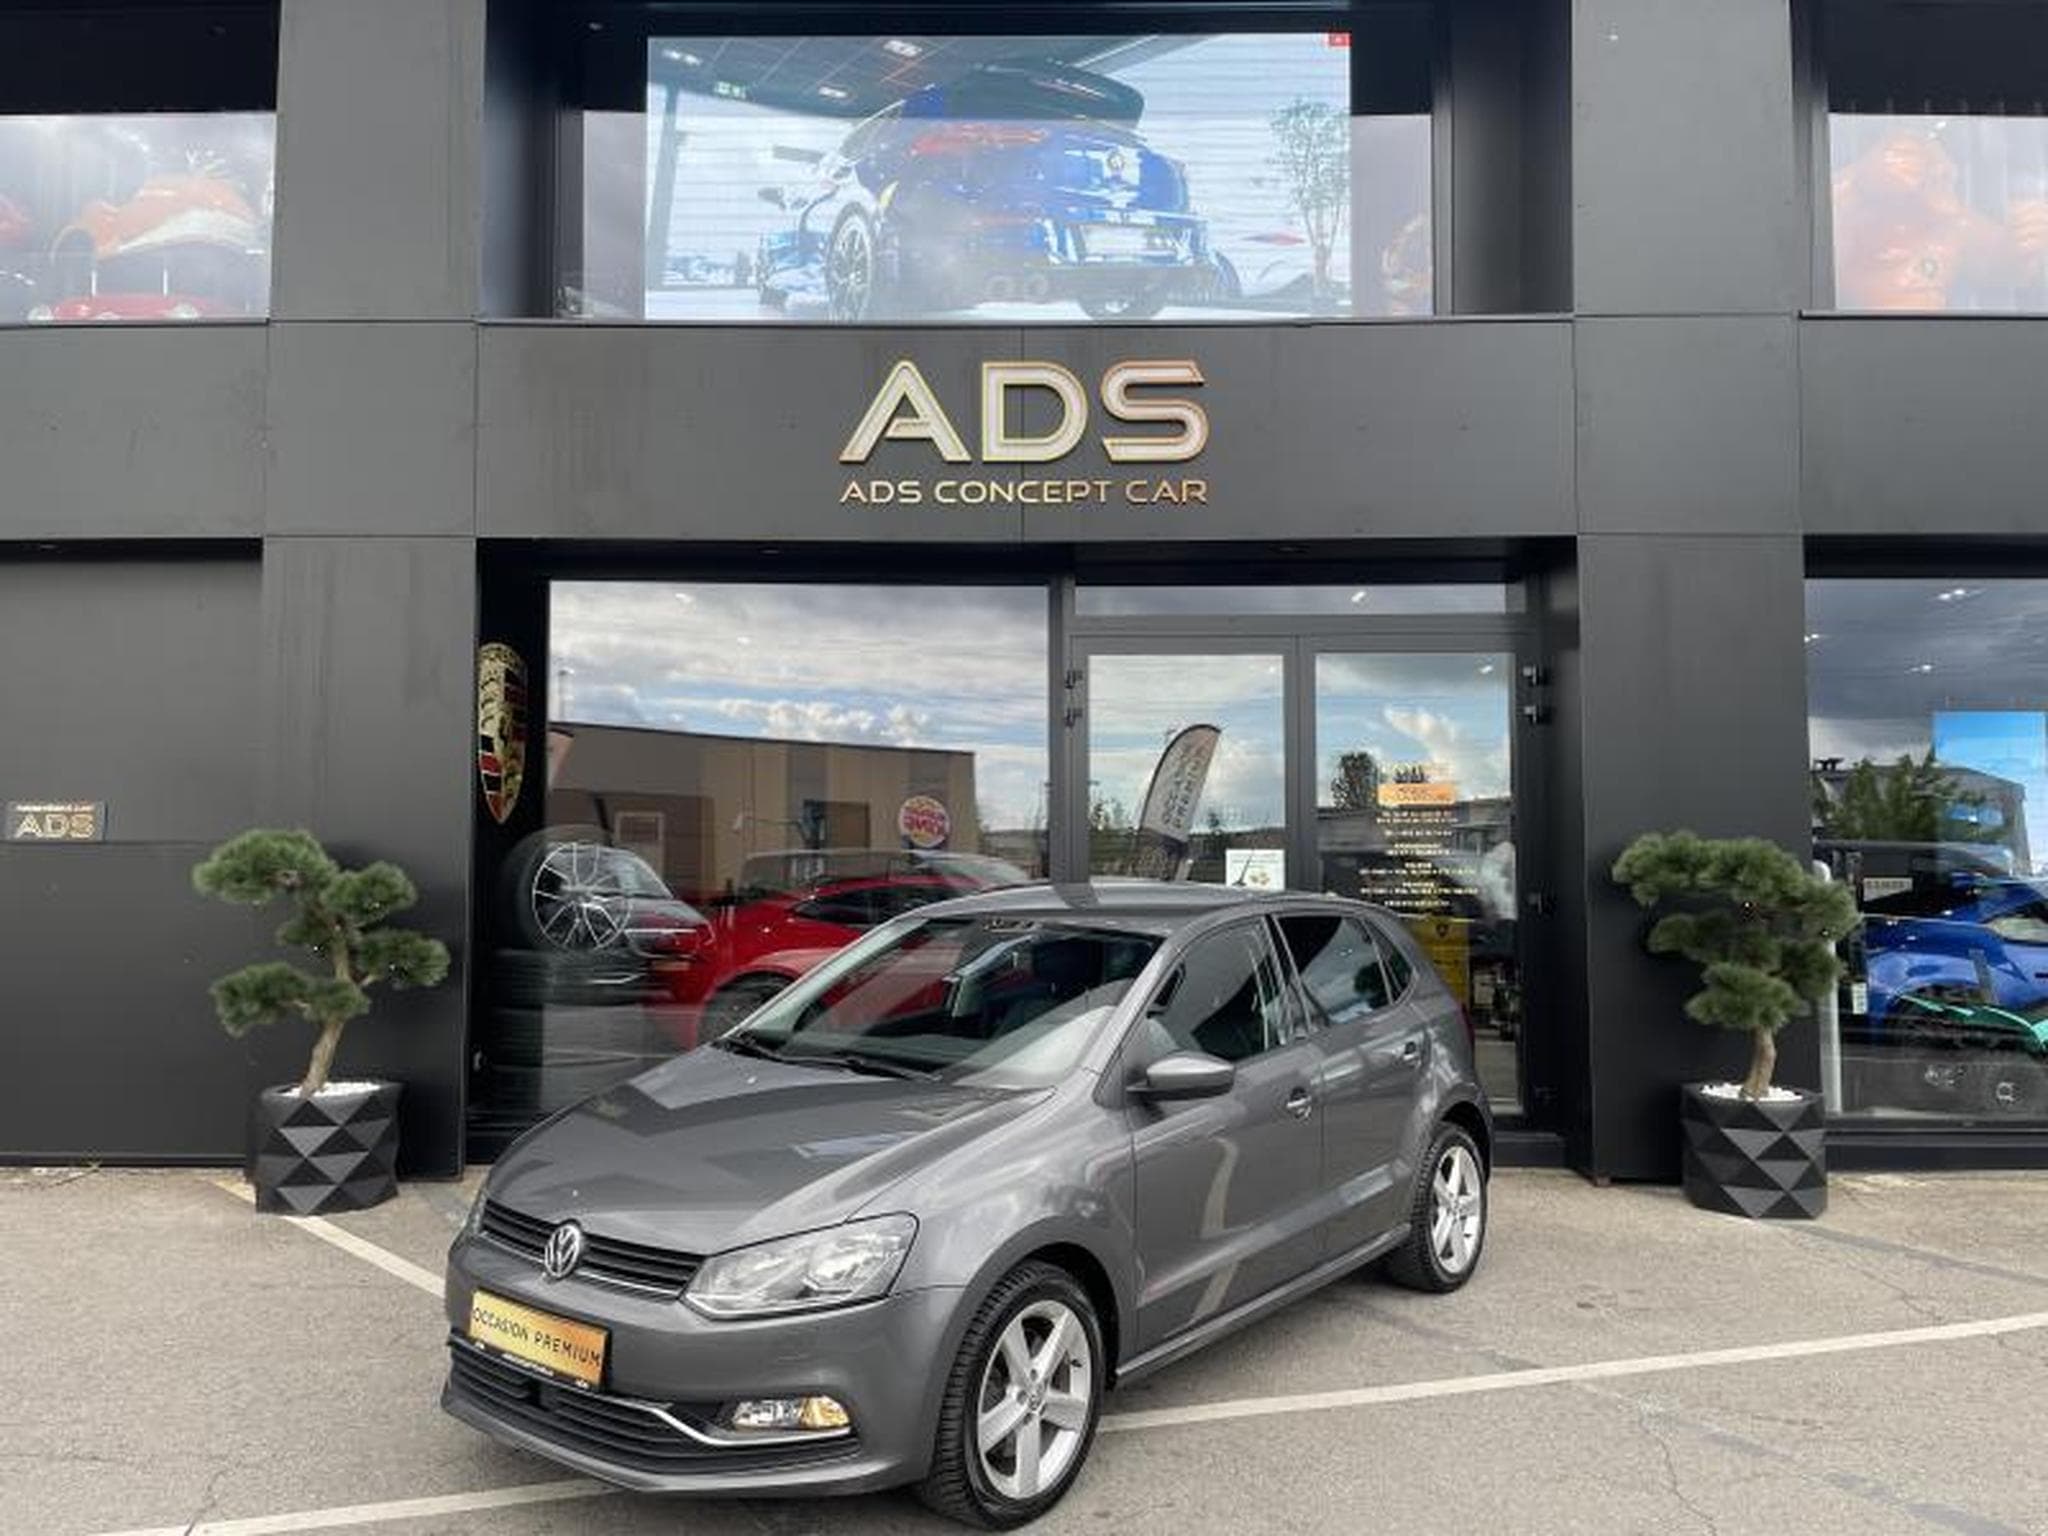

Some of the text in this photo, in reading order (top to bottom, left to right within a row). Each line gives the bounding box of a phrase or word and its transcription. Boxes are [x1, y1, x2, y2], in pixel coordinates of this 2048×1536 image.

[839, 359, 1210, 463] ADS
[839, 479, 1209, 504] ADS CONCEPT CAR
[14, 813, 95, 838] ADS
[472, 1307, 529, 1341] OCCASION
[534, 1331, 601, 1367] PREMIUM
